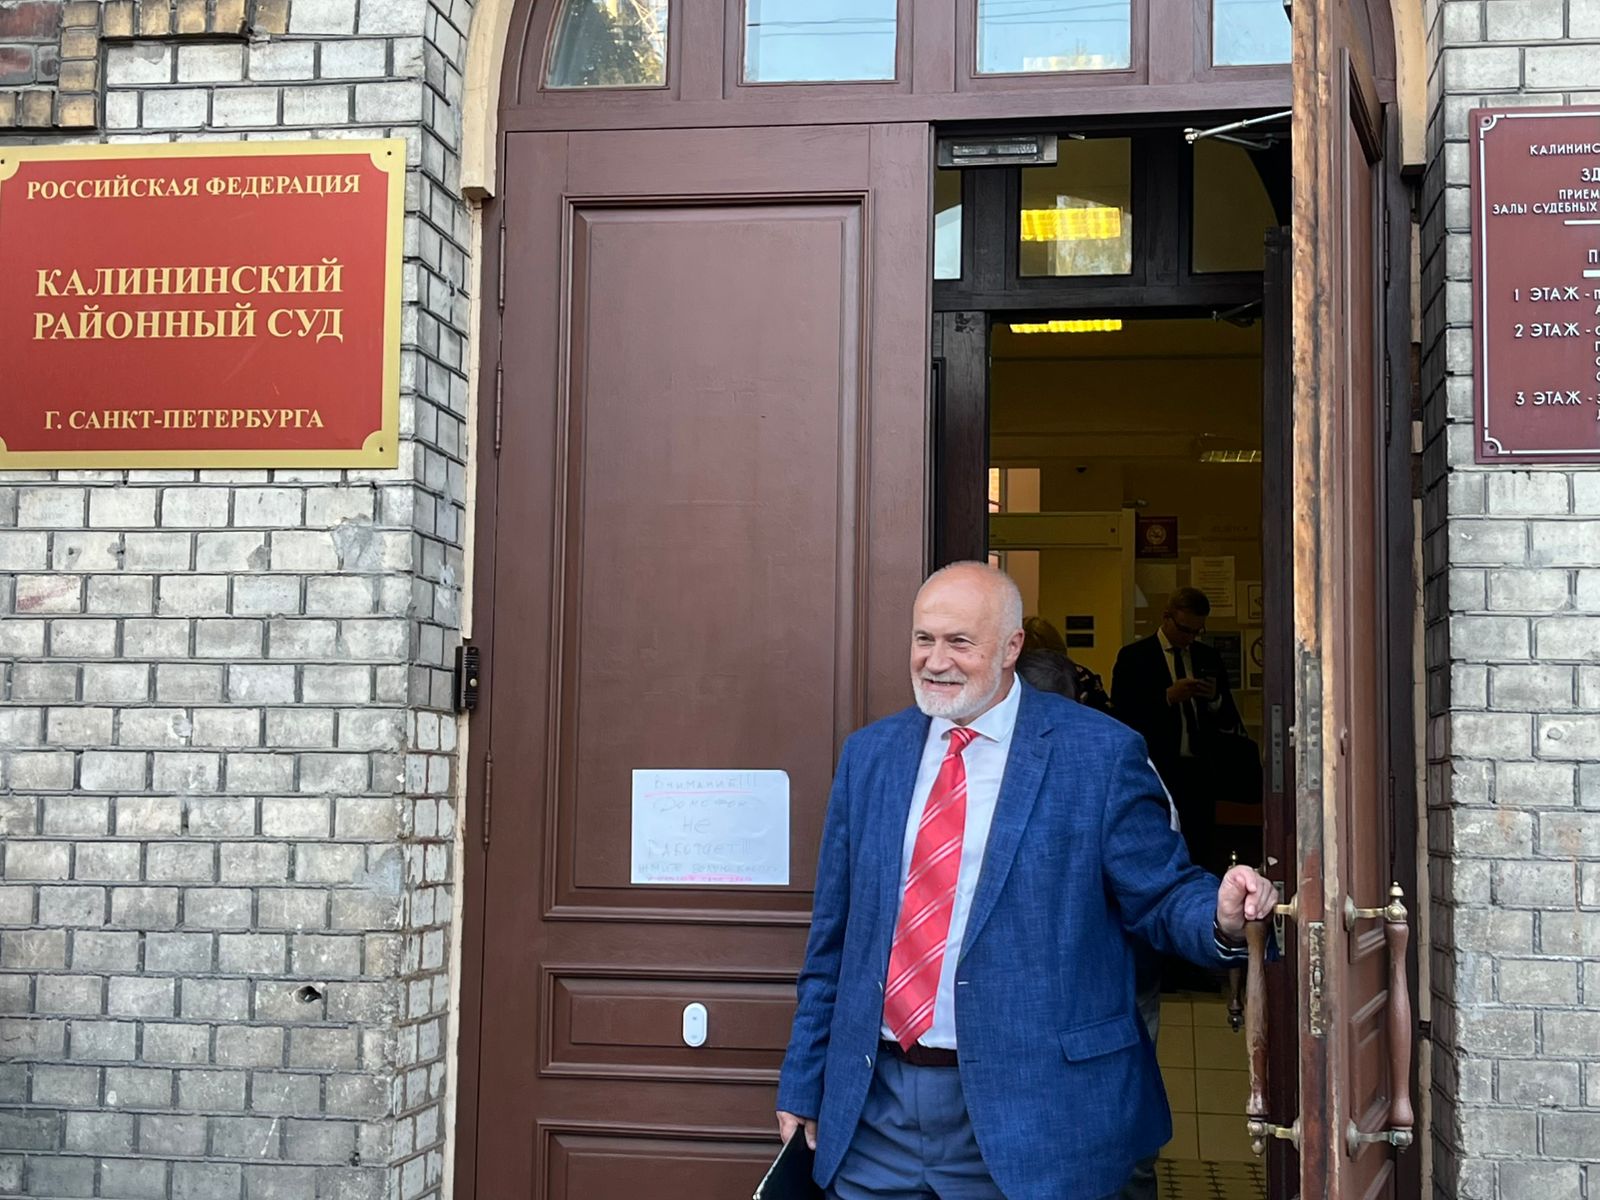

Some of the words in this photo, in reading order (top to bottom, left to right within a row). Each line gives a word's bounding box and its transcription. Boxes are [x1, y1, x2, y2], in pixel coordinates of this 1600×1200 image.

[27, 175, 199, 199] РОССИЙСКАЯ
[205, 174, 361, 198] ФЕДЕРАЦИЯ
[1492, 203, 1527, 215] ЗАЛЫ
[1533, 202, 1597, 214] СУДЕБНЫХ
[36, 257, 344, 297] КАЛИНИНСКИЙ
[1530, 287, 1579, 301] ЭТАЖ
[33, 302, 257, 340] РАЙОННЫЙ
[267, 308, 344, 344] СУД
[1514, 324, 1523, 337] 2
[1530, 323, 1580, 336] ЭТАЖ
[1515, 392, 1525, 405] 3
[1533, 391, 1581, 405] ЭТАЖ
[44, 411, 62, 429] Г.
[69, 409, 324, 429] САНКТ-ПЕТЕРБУРГА
